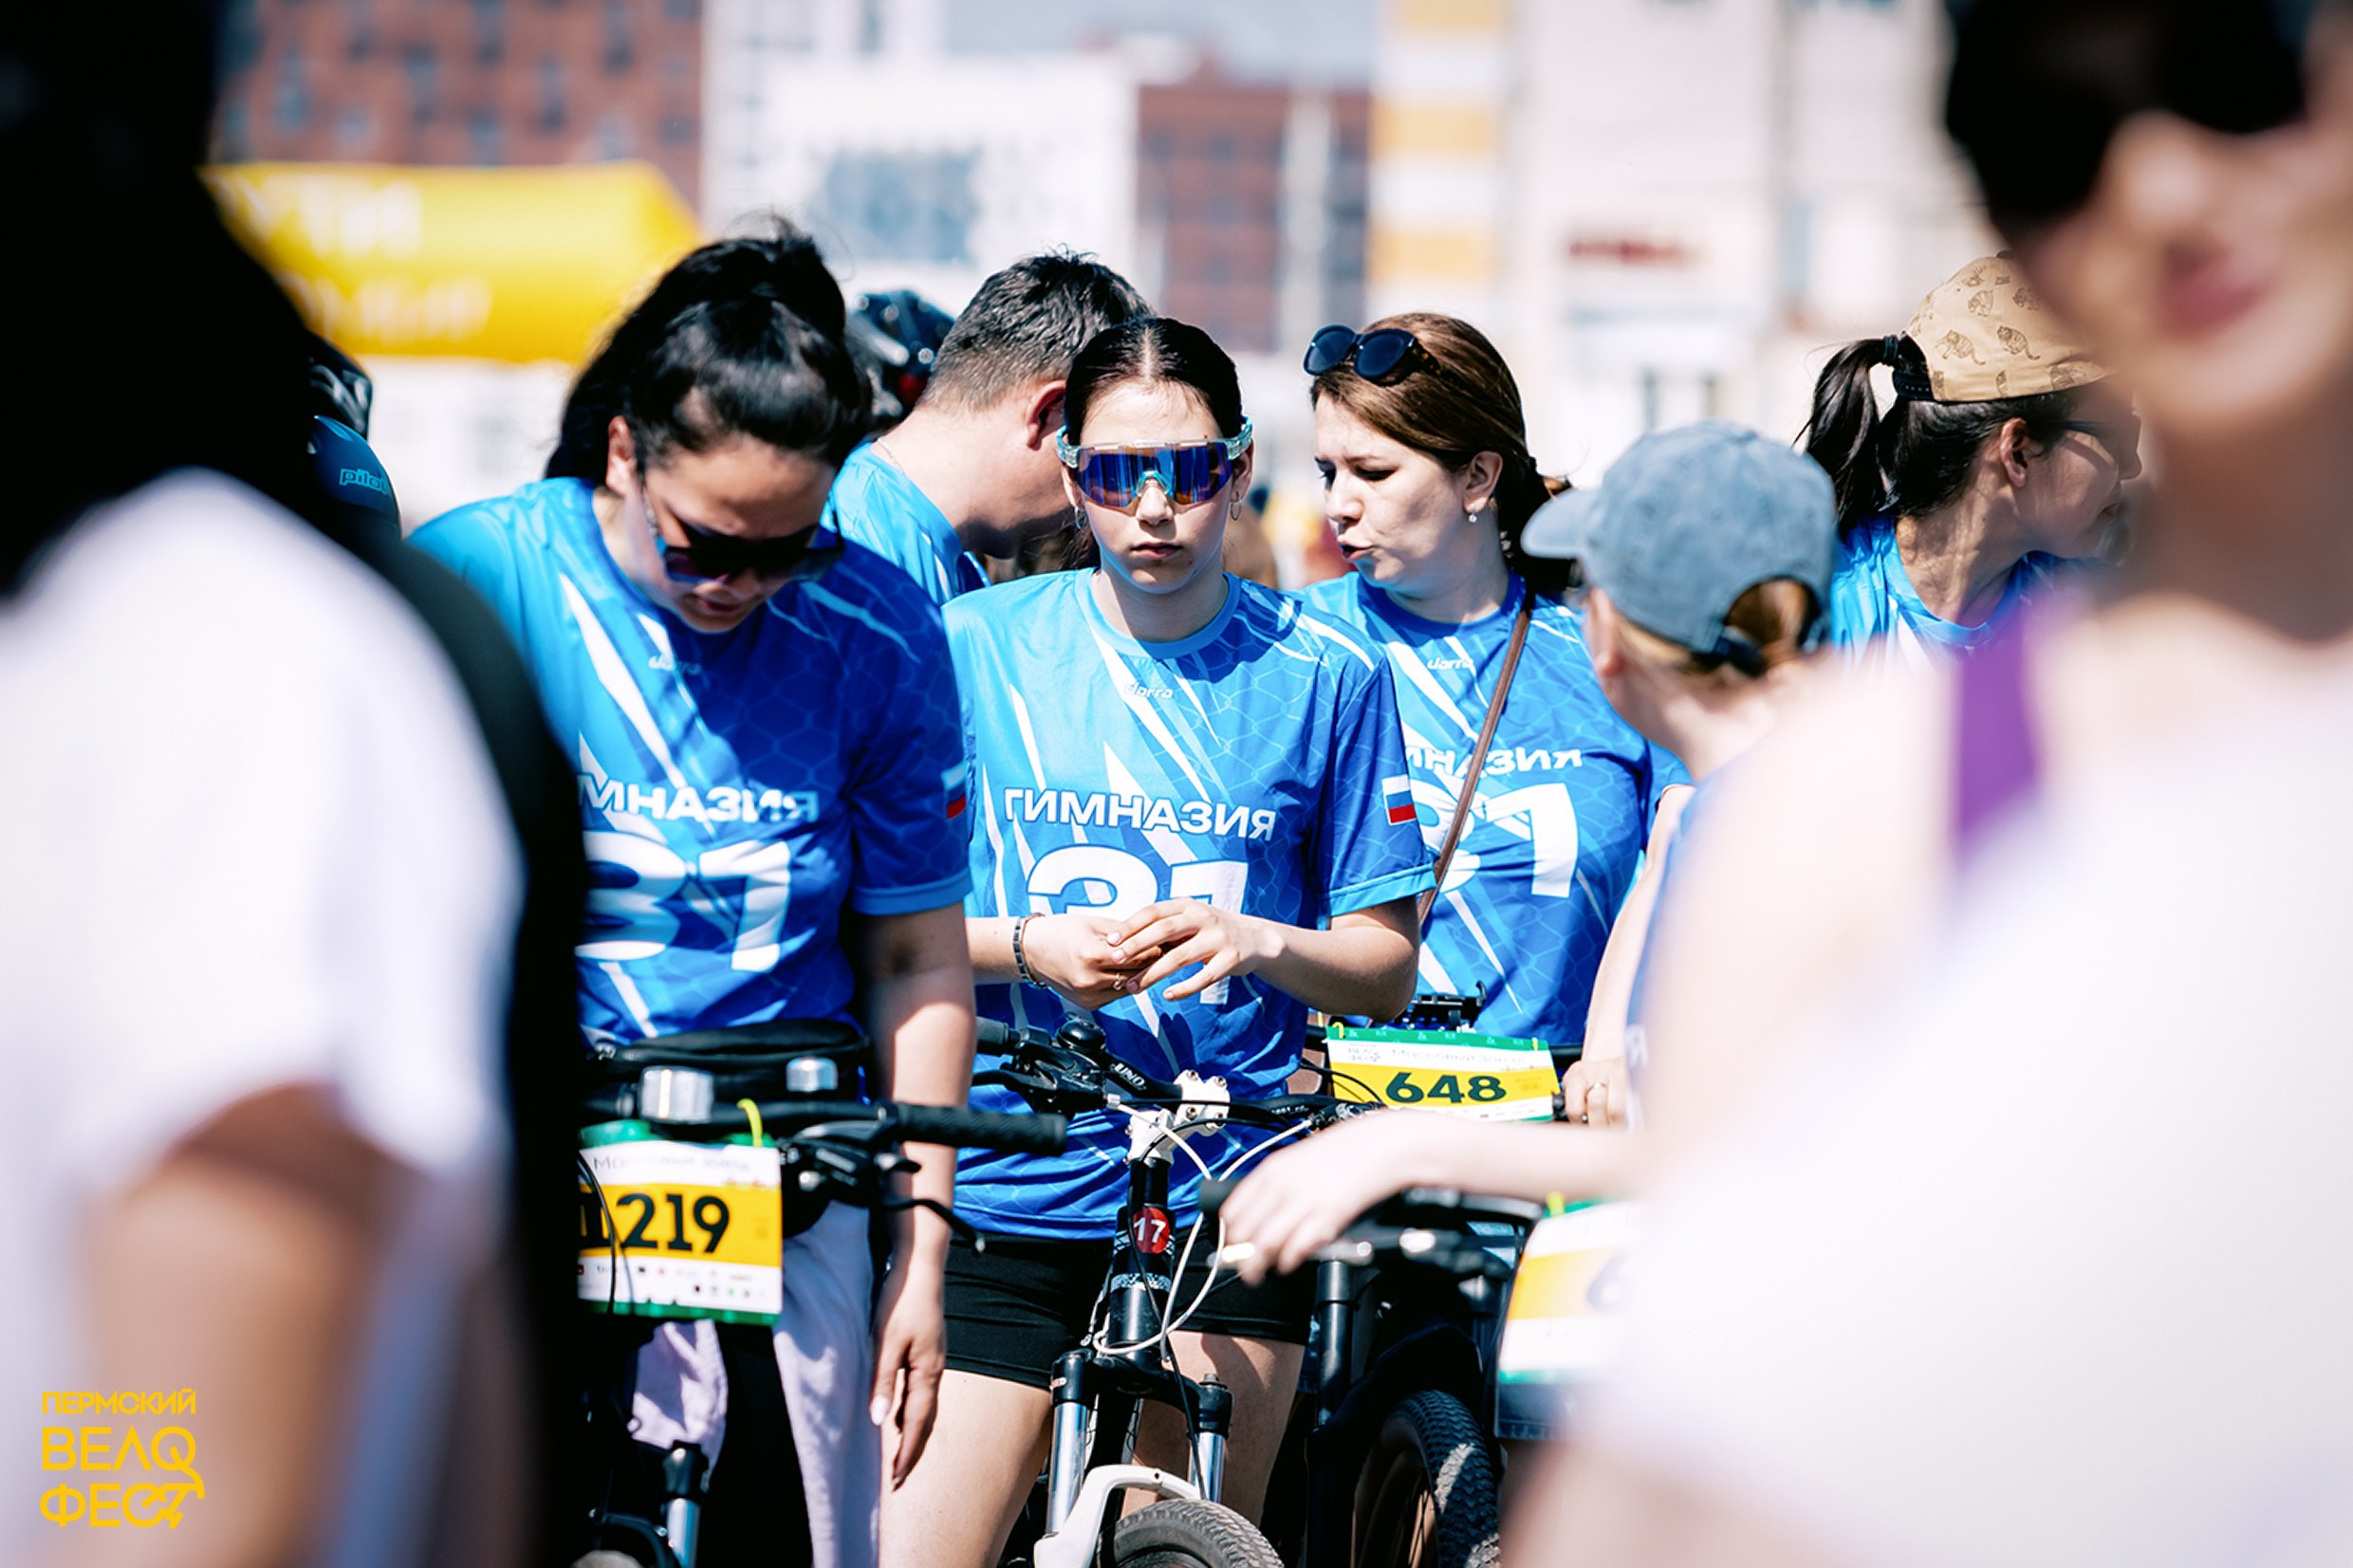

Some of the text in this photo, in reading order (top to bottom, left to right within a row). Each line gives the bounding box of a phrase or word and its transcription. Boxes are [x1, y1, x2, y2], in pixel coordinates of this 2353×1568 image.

[1405, 747, 1584, 779] НАЗИЯ
[577, 774, 819, 822] МНАЗИЯ
[1004, 787, 1277, 841] ГИМНАЗИЯ
[1385, 1071, 1507, 1104] 648
[1133, 1216, 1167, 1244] 17
